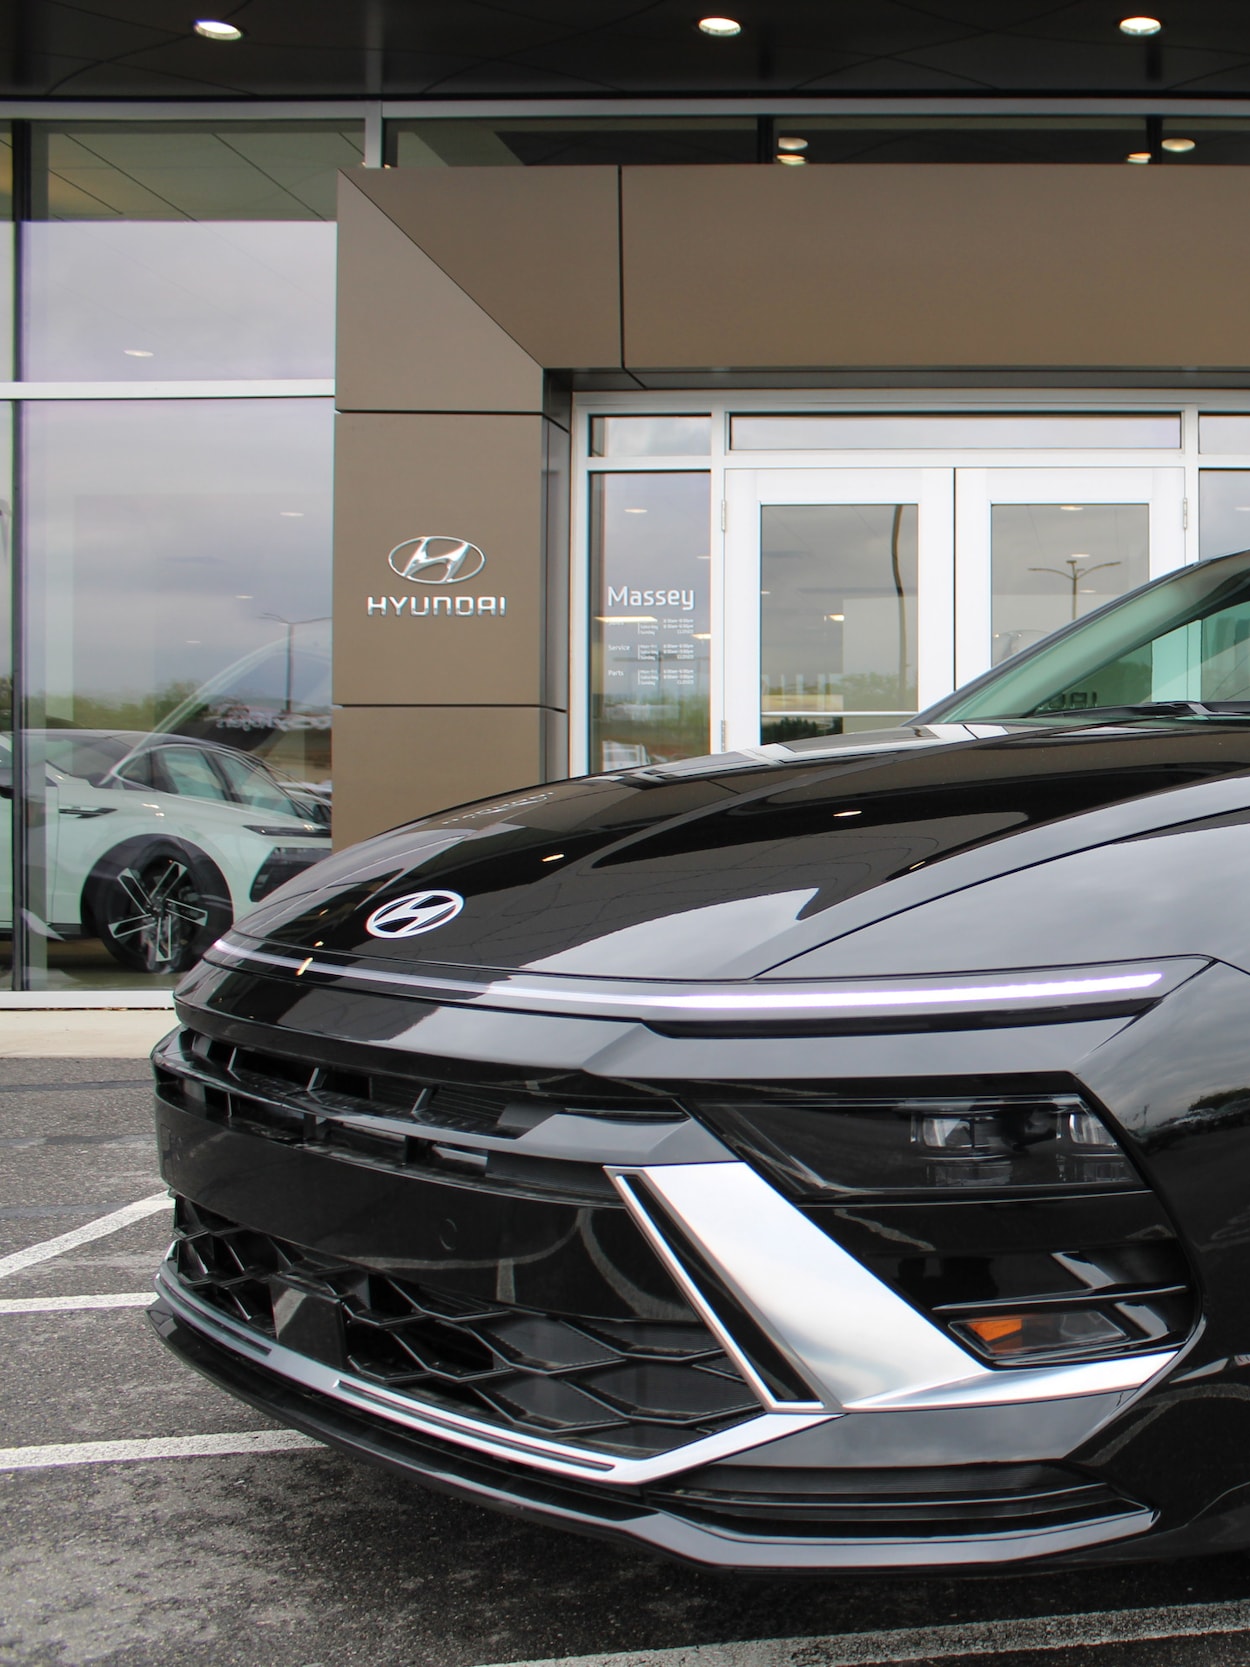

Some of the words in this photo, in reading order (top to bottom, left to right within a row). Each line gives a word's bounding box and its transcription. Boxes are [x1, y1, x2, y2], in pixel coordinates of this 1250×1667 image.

[366, 596, 507, 616] HYUNDAI
[607, 585, 695, 610] Massey
[607, 669, 624, 677] Parts
